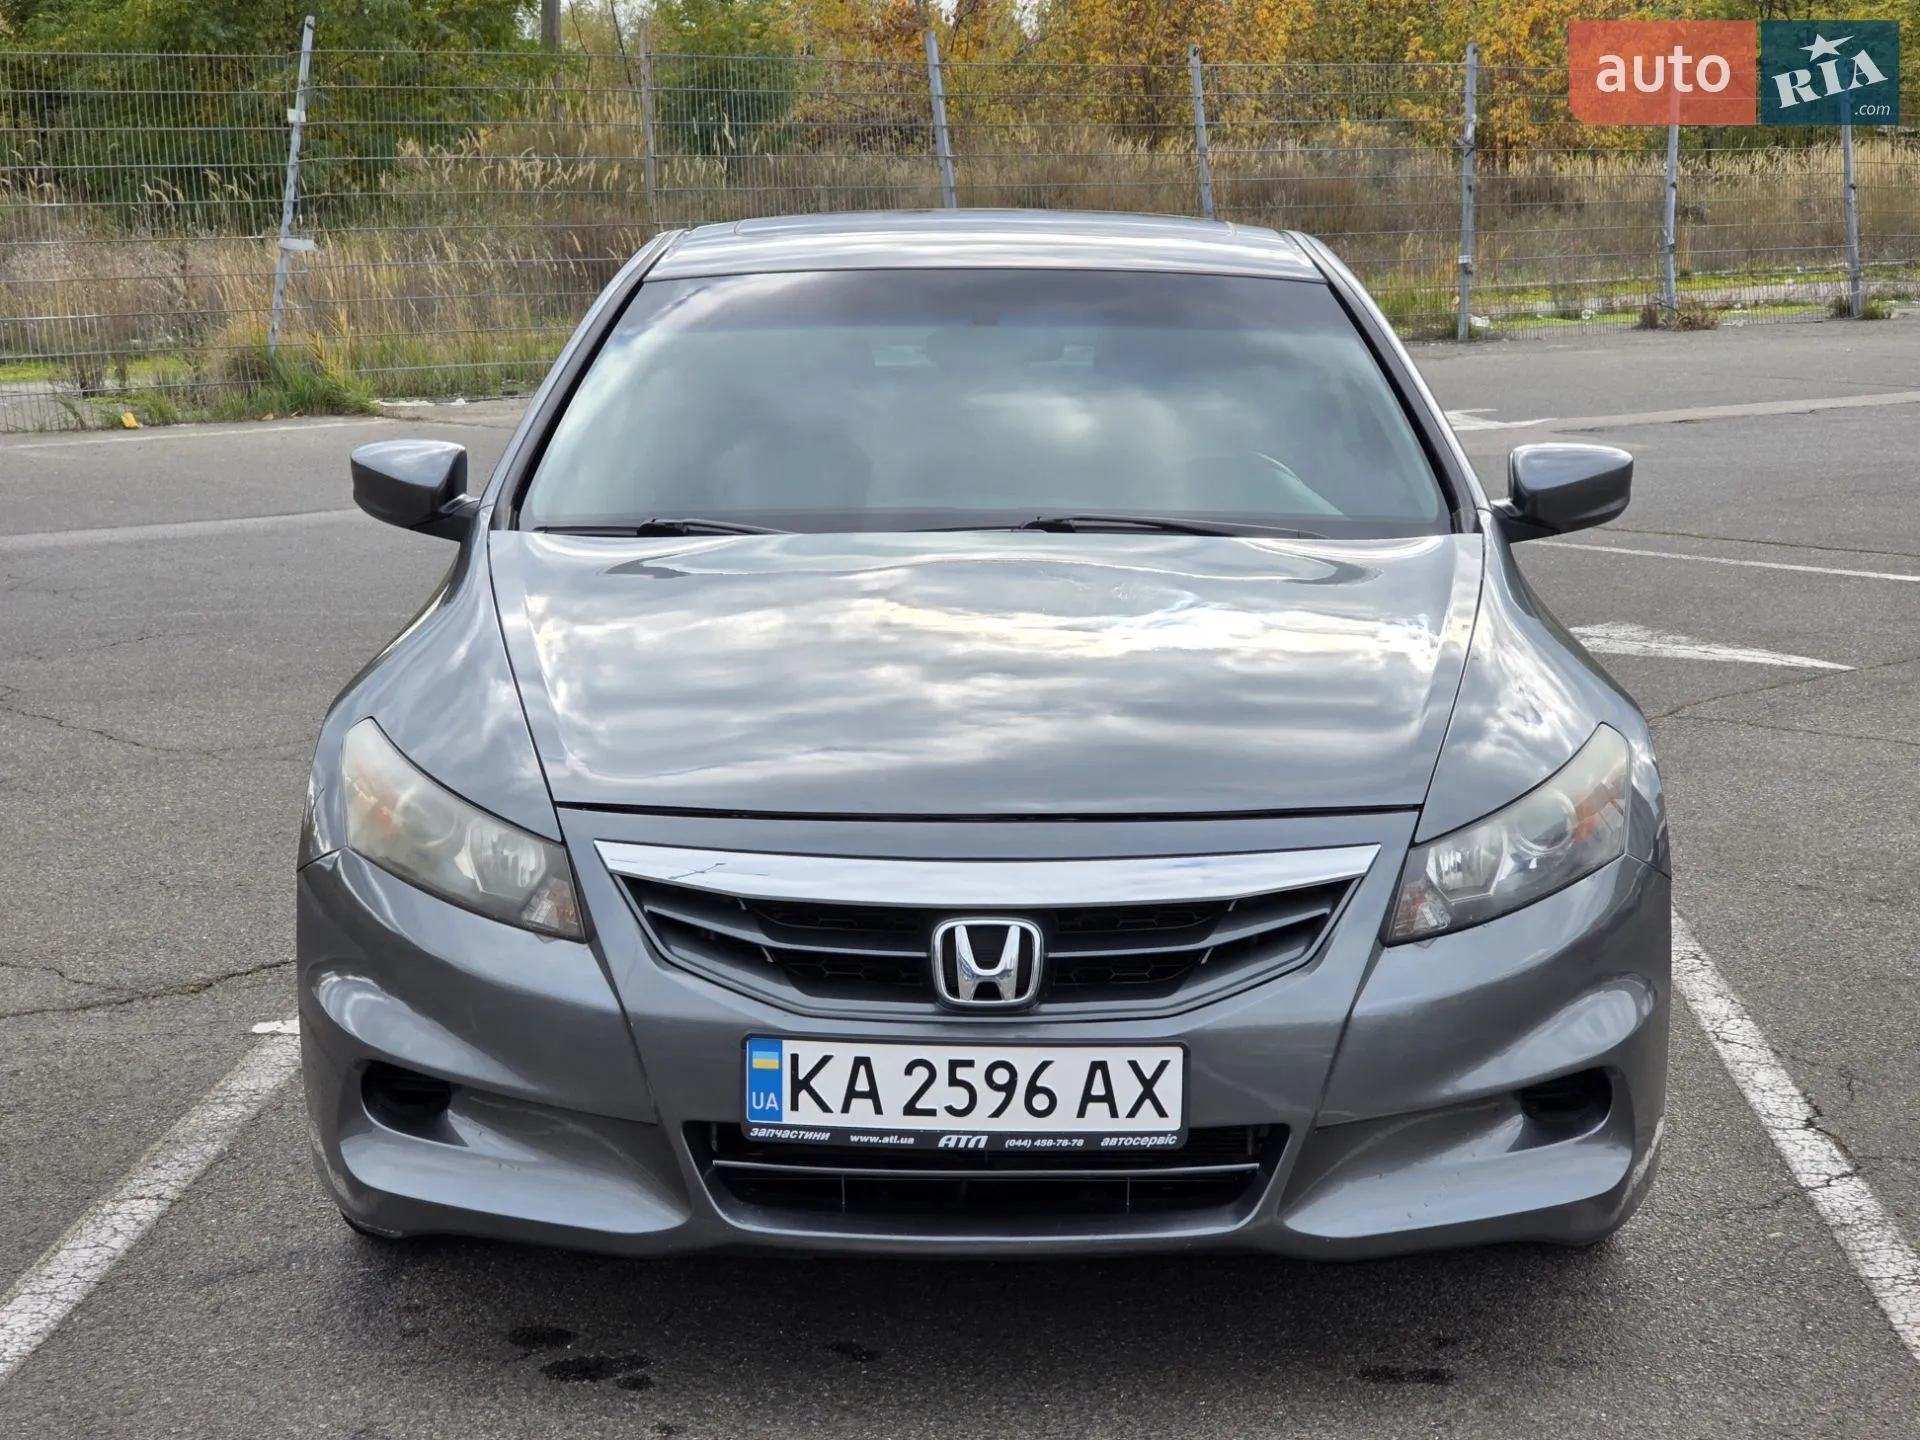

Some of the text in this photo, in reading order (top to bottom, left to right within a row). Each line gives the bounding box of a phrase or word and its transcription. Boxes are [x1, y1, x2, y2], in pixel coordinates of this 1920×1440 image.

[789, 1053, 1171, 1119] KA 2596 AX
[752, 1092, 779, 1111] UA
[749, 1126, 831, 1141] запчастини
[849, 1135, 915, 1145] www.atl.ua
[1100, 1133, 1178, 1147] автосервіс
[1005, 1139, 1032, 1149] (044)
